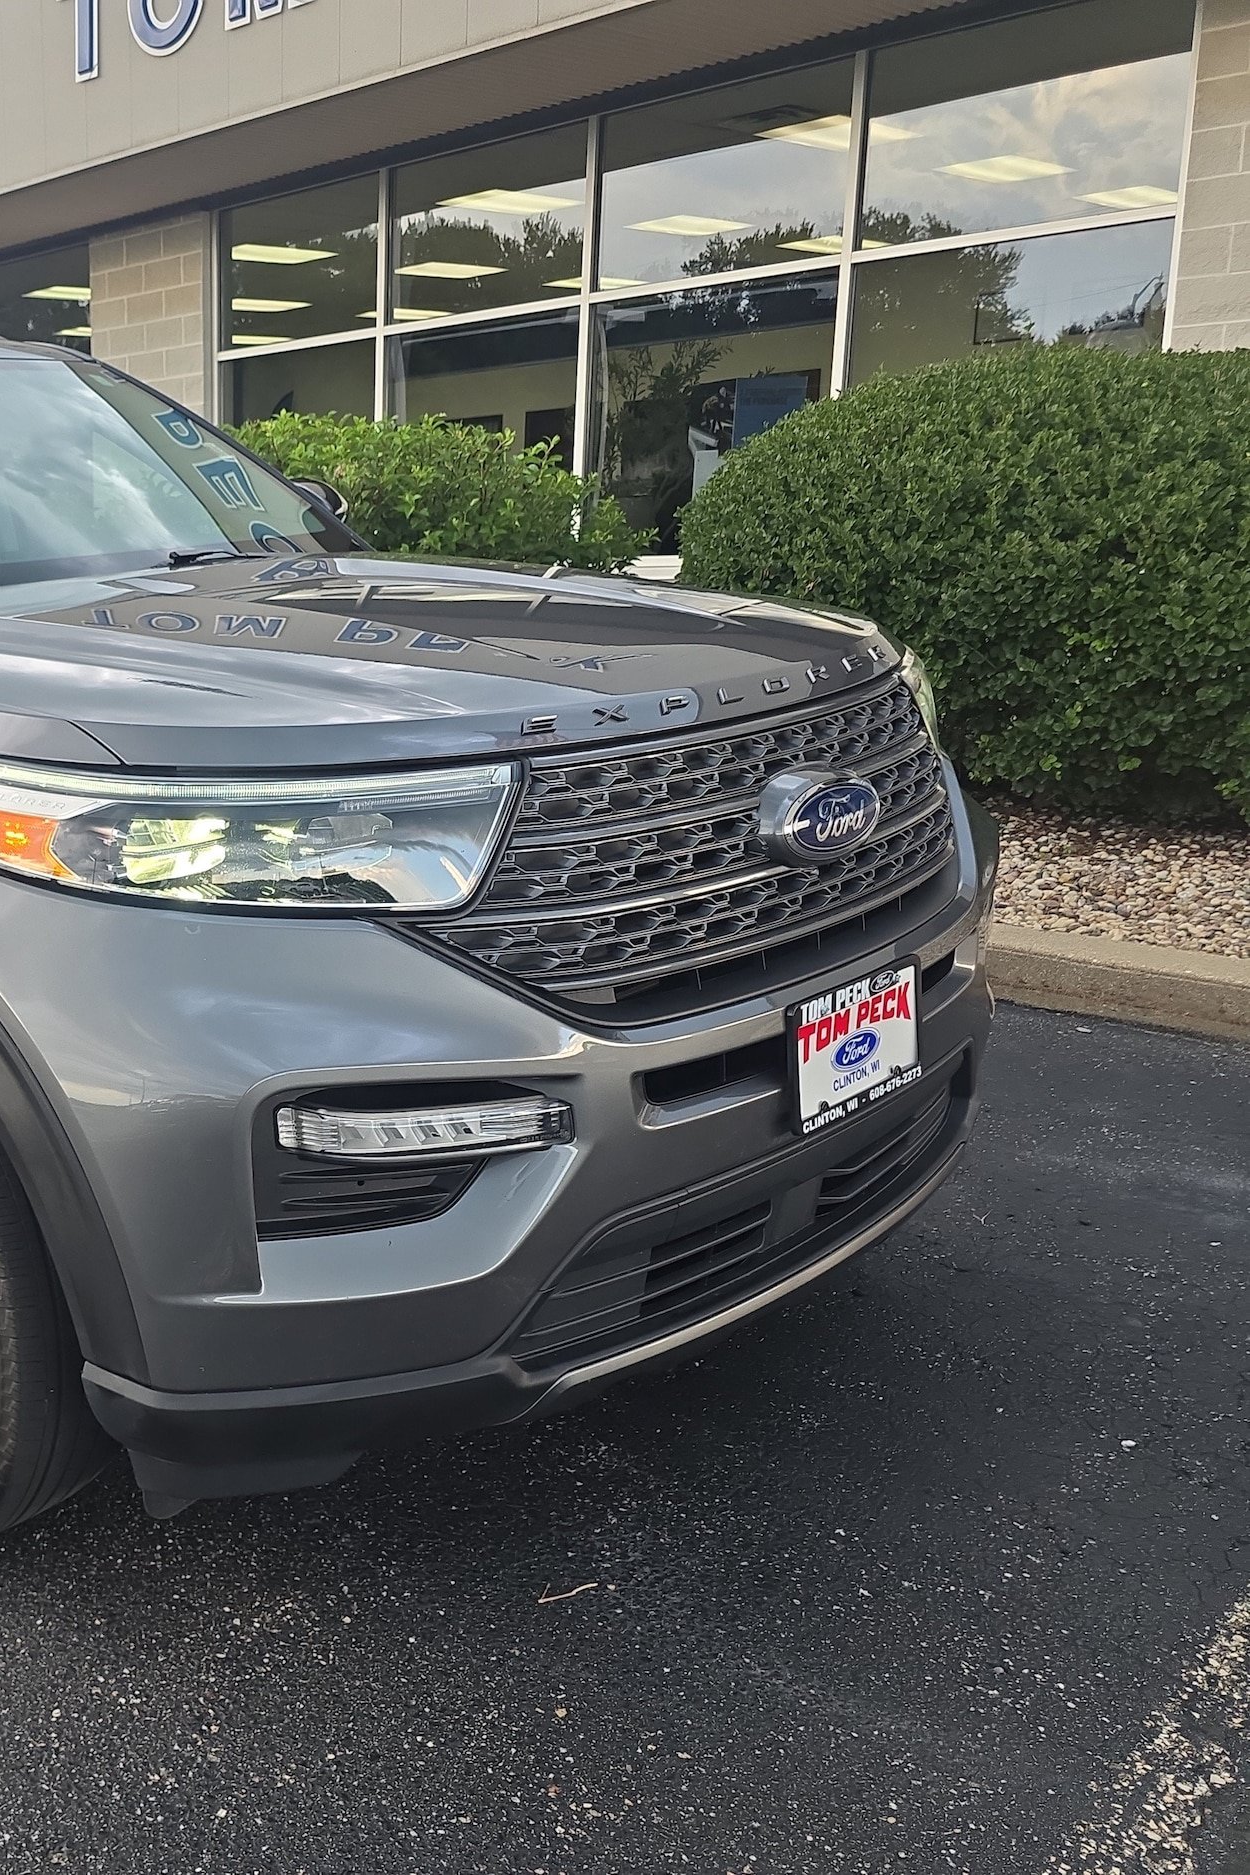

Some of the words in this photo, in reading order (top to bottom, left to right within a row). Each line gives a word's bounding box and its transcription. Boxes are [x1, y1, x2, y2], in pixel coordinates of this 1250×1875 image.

[521, 644, 887, 737] EXPLORER
[815, 794, 867, 843] Ford
[797, 1008, 851, 1064] TOM
[856, 981, 912, 1028] PECK
[800, 992, 833, 1025] TOM
[835, 977, 871, 1011] PECK
[803, 1105, 846, 1134] CLINTON,
[847, 1097, 859, 1112] WI
[869, 1065, 922, 1102] 608-676-2273
[833, 1065, 870, 1092] CLINTON,
[870, 1059, 881, 1074] WI
